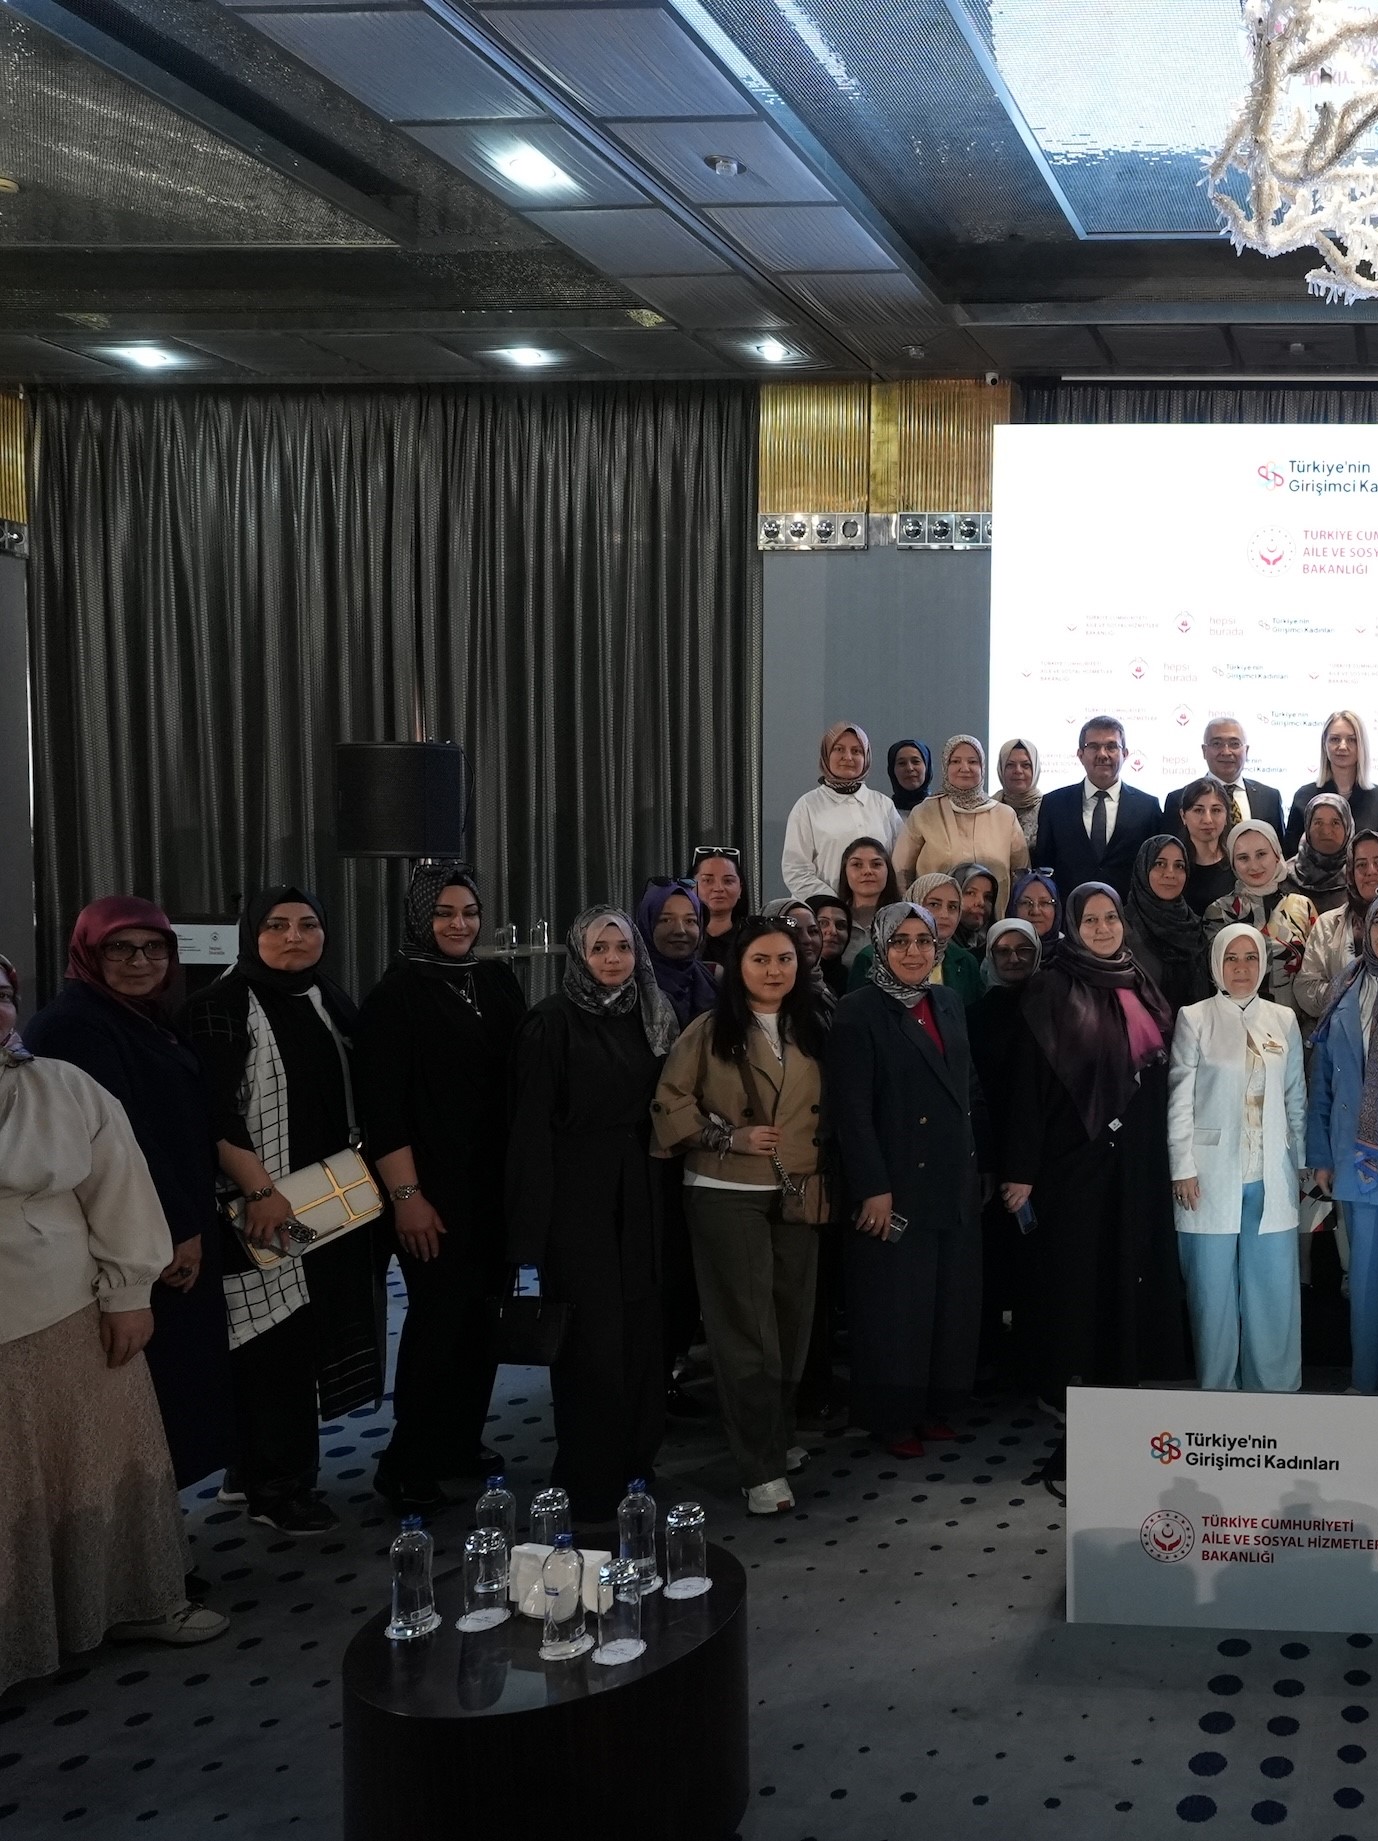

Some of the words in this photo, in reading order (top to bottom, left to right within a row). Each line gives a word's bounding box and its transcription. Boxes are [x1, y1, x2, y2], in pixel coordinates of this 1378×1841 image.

[1288, 460, 1371, 476] Türkiye'nin
[1288, 479, 1356, 496] Girişimci
[1331, 547, 1346, 558] VE
[1302, 562, 1368, 575] BAKANLIĞI
[1185, 1432, 1277, 1451] Türkiye'nin
[1185, 1452, 1261, 1471] Girişimci
[1264, 1454, 1340, 1471] Kadınları
[1201, 1514, 1258, 1529] TÜRKİYE
[1261, 1518, 1354, 1532] CUMHURİYETİ
[1202, 1531, 1231, 1545] AİLE
[1233, 1534, 1250, 1546] VE
[1253, 1535, 1304, 1548] SOSYAL
[1201, 1550, 1275, 1564] BAKANLIĞI
